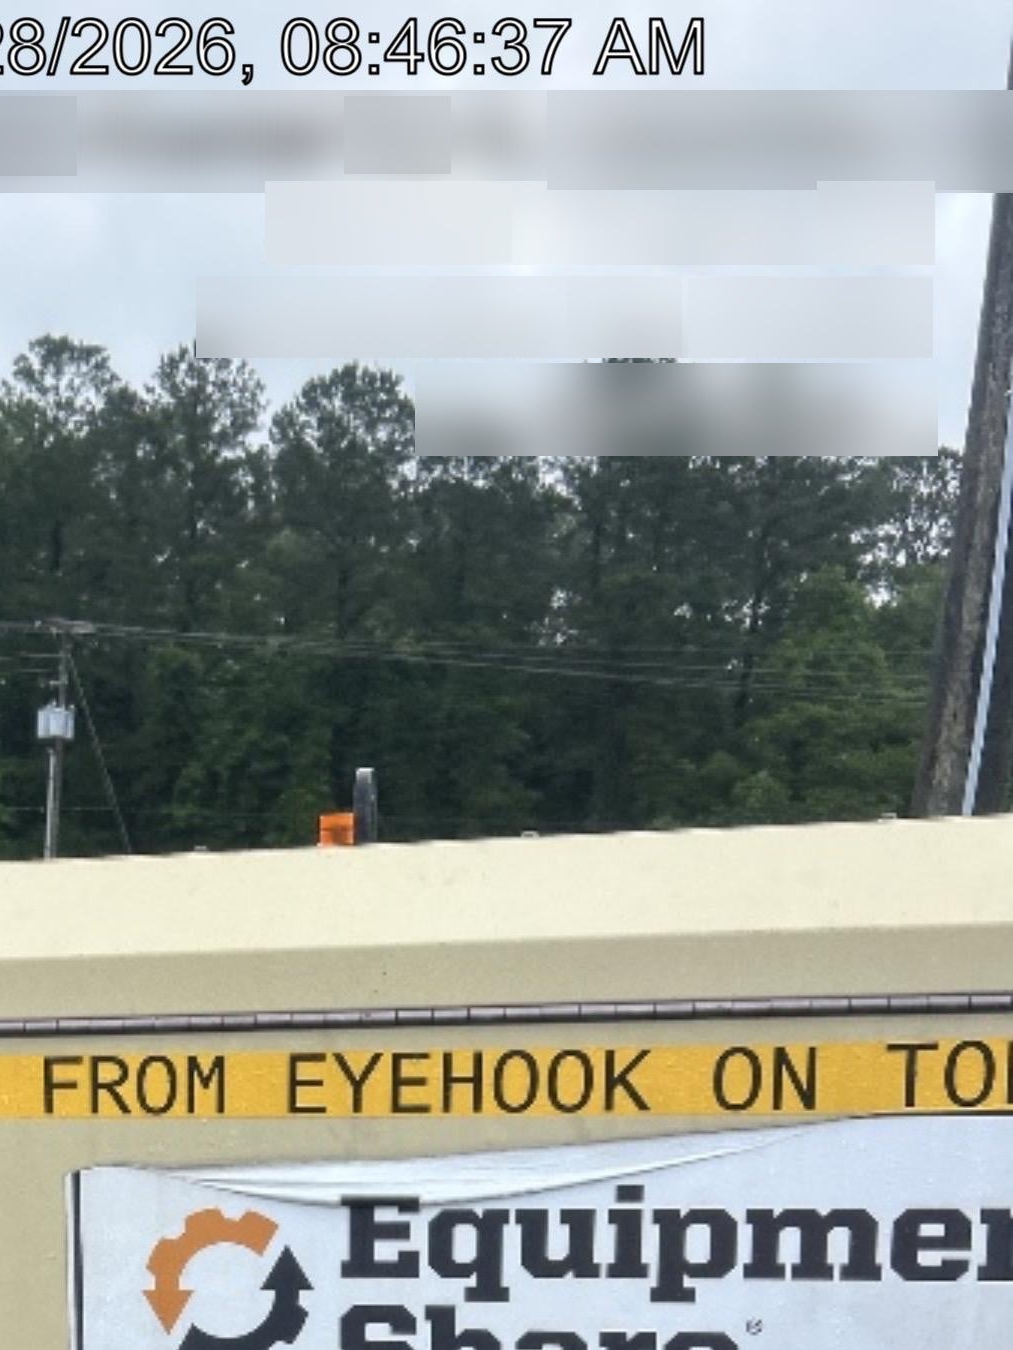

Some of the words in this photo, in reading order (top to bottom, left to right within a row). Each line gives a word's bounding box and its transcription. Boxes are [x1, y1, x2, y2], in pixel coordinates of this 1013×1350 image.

[42, 1055, 226, 1117] FROM
[287, 1049, 652, 1114] EYEHOOK
[712, 1046, 817, 1112] ON
[885, 1040, 1013, 1108] TO
